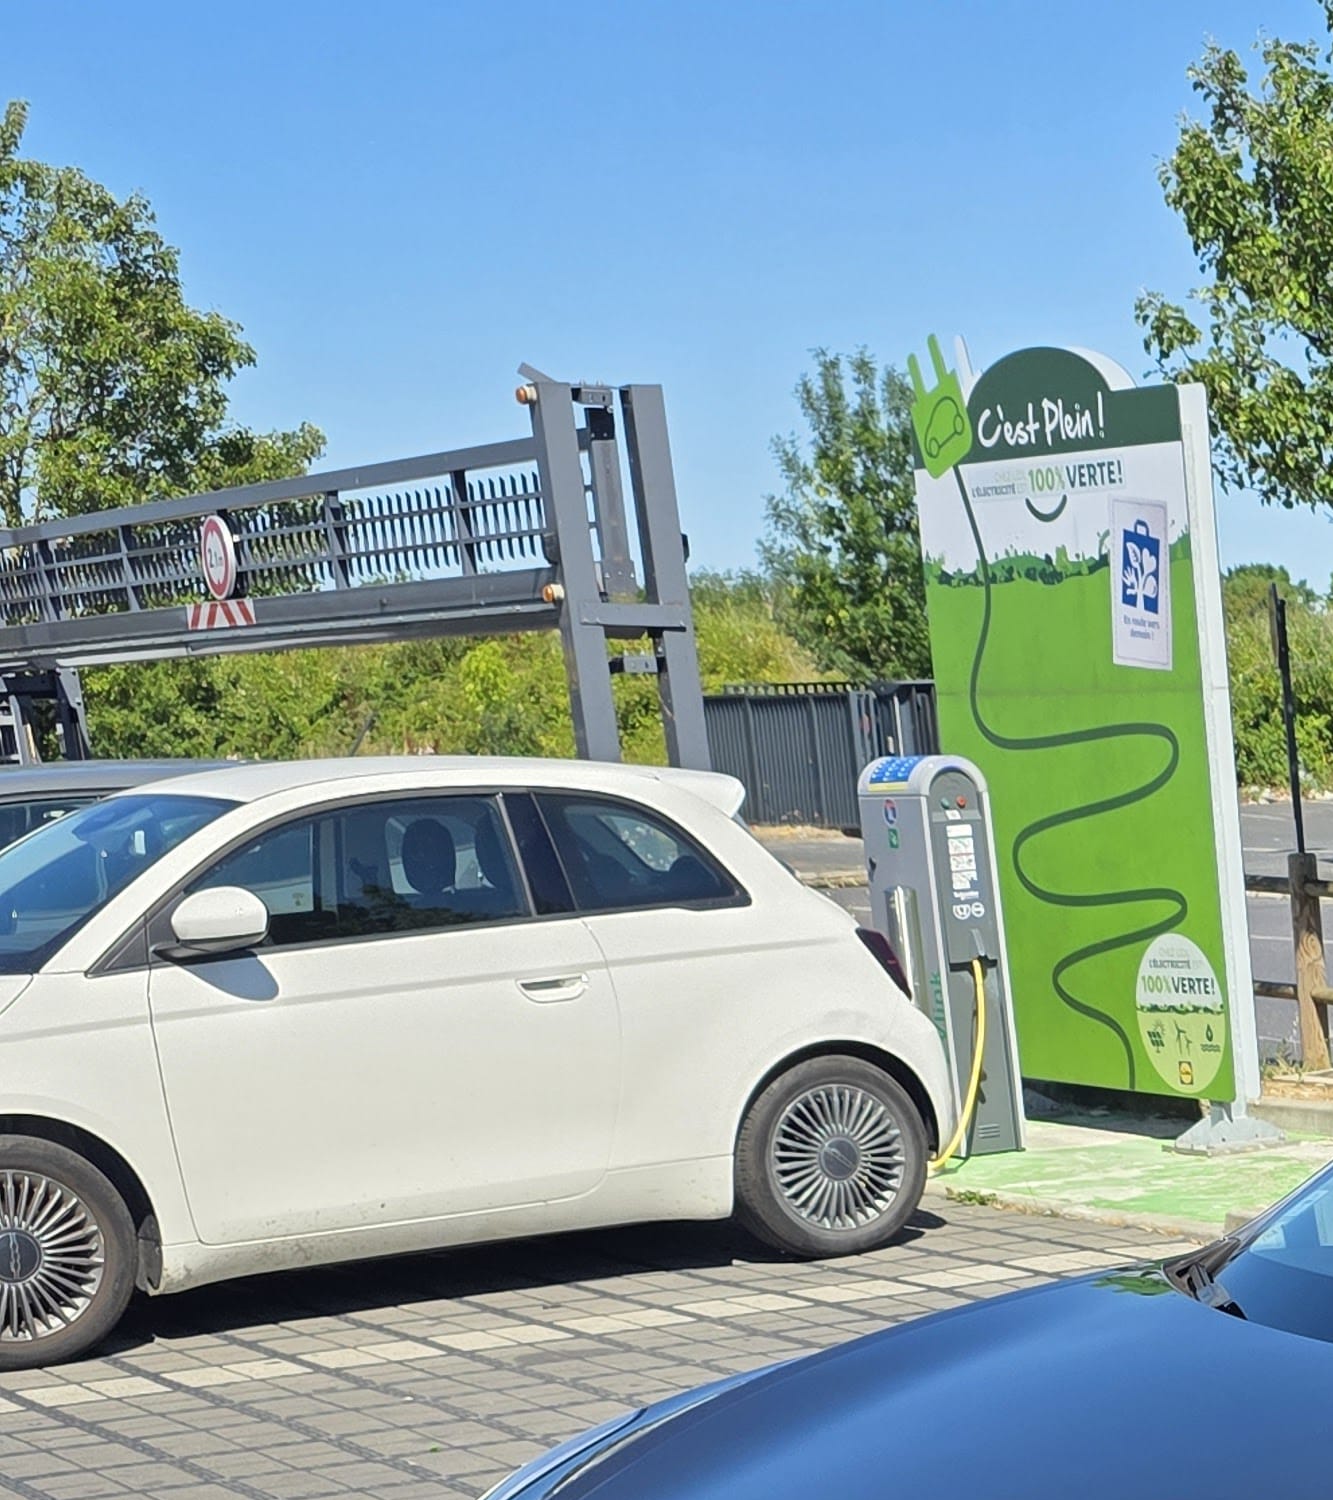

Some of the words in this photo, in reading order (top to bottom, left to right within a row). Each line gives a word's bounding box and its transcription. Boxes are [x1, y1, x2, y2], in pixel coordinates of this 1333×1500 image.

[978, 404, 1040, 448] C'est
[1042, 397, 1094, 446] Plein
[1028, 463, 1065, 493] 100%
[1066, 460, 1123, 489] VERTE!
[1141, 975, 1171, 994] 100%
[1171, 976, 1215, 996] VERTE!
